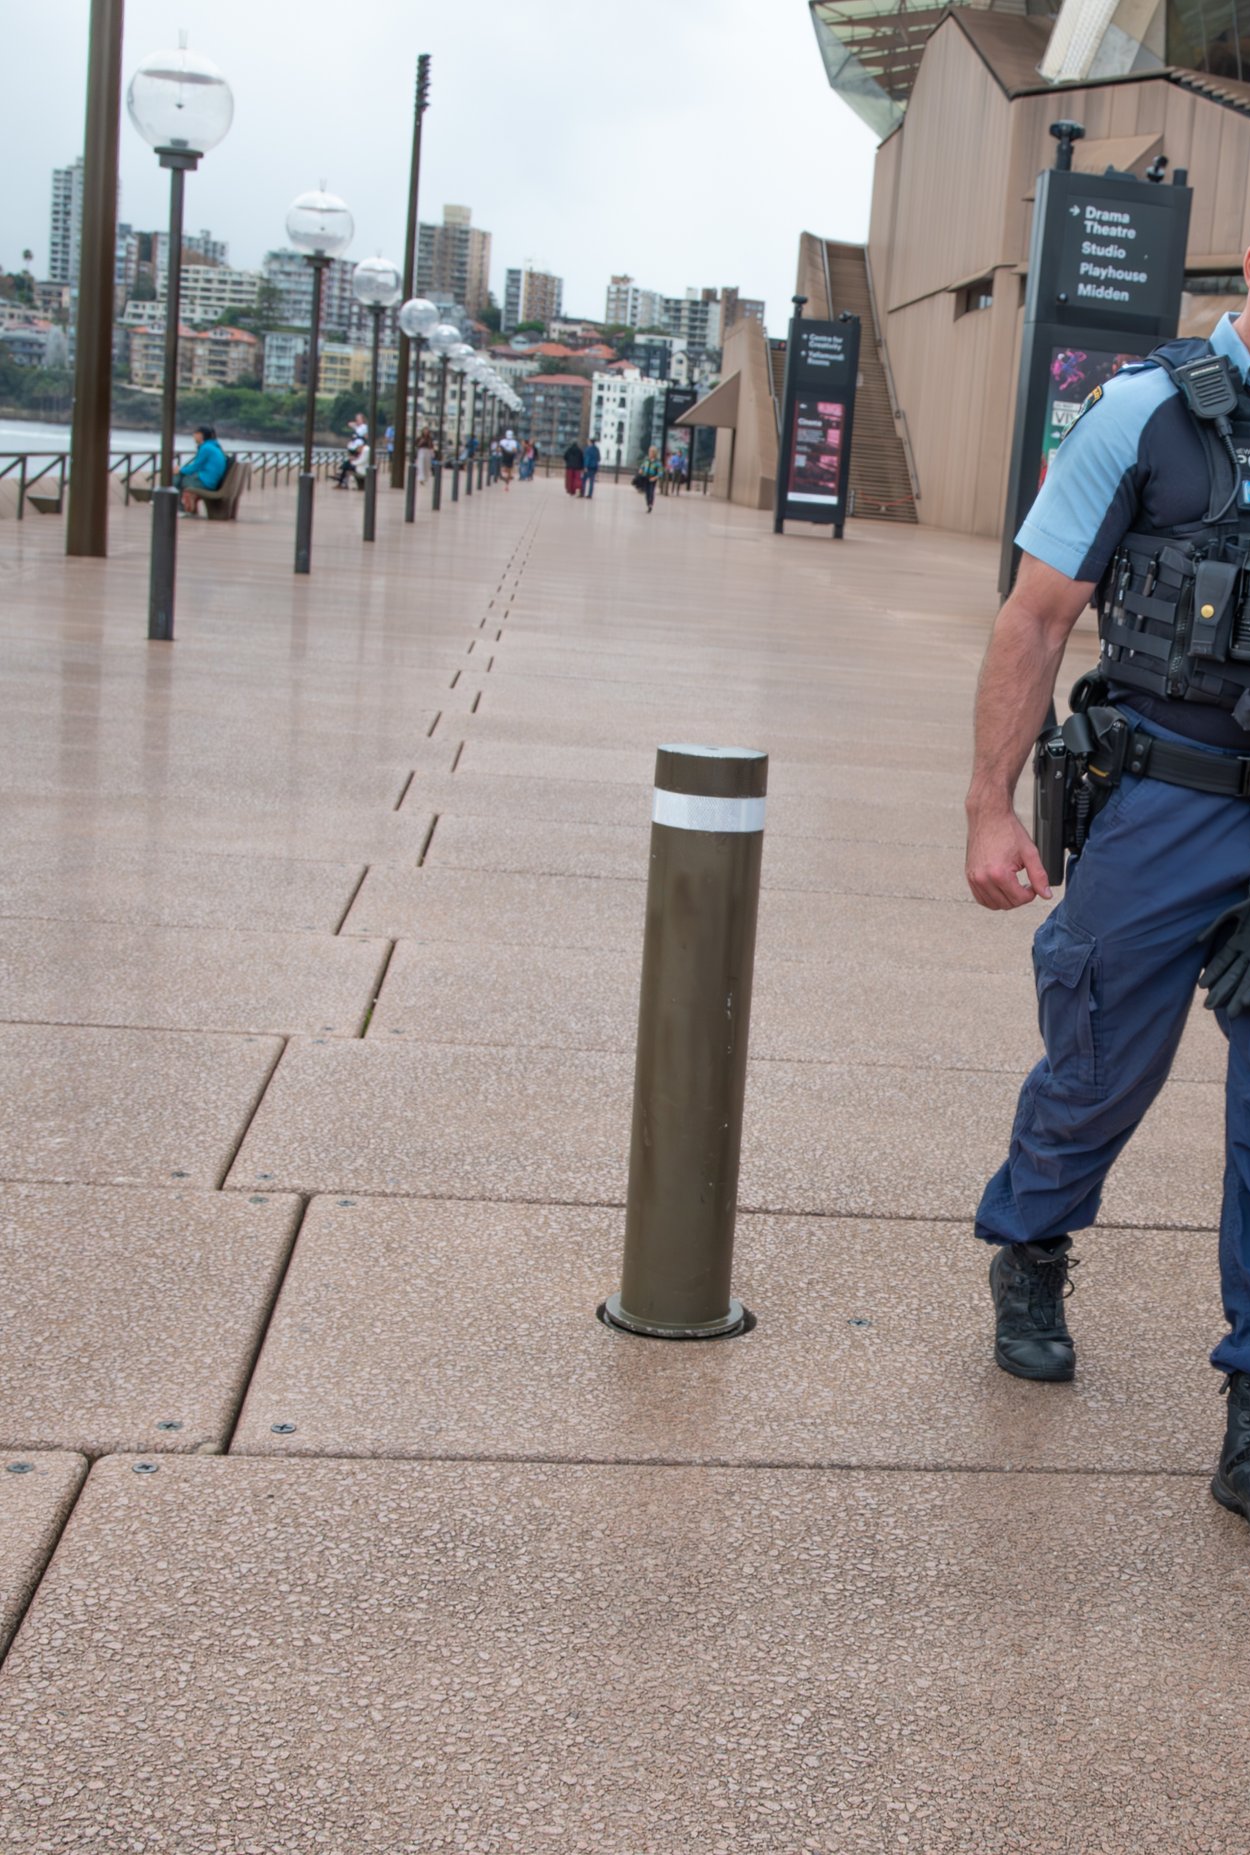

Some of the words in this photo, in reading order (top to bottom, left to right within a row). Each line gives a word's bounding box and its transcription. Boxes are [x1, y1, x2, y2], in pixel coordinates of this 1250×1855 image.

[1085, 205, 1130, 224] Drama
[1084, 220, 1136, 239] Theatre
[1081, 241, 1126, 259] Studio
[1080, 262, 1147, 283] Playhouse
[1077, 283, 1129, 302] Midden
[808, 341, 843, 351] Creativity
[809, 333, 832, 343] Centre
